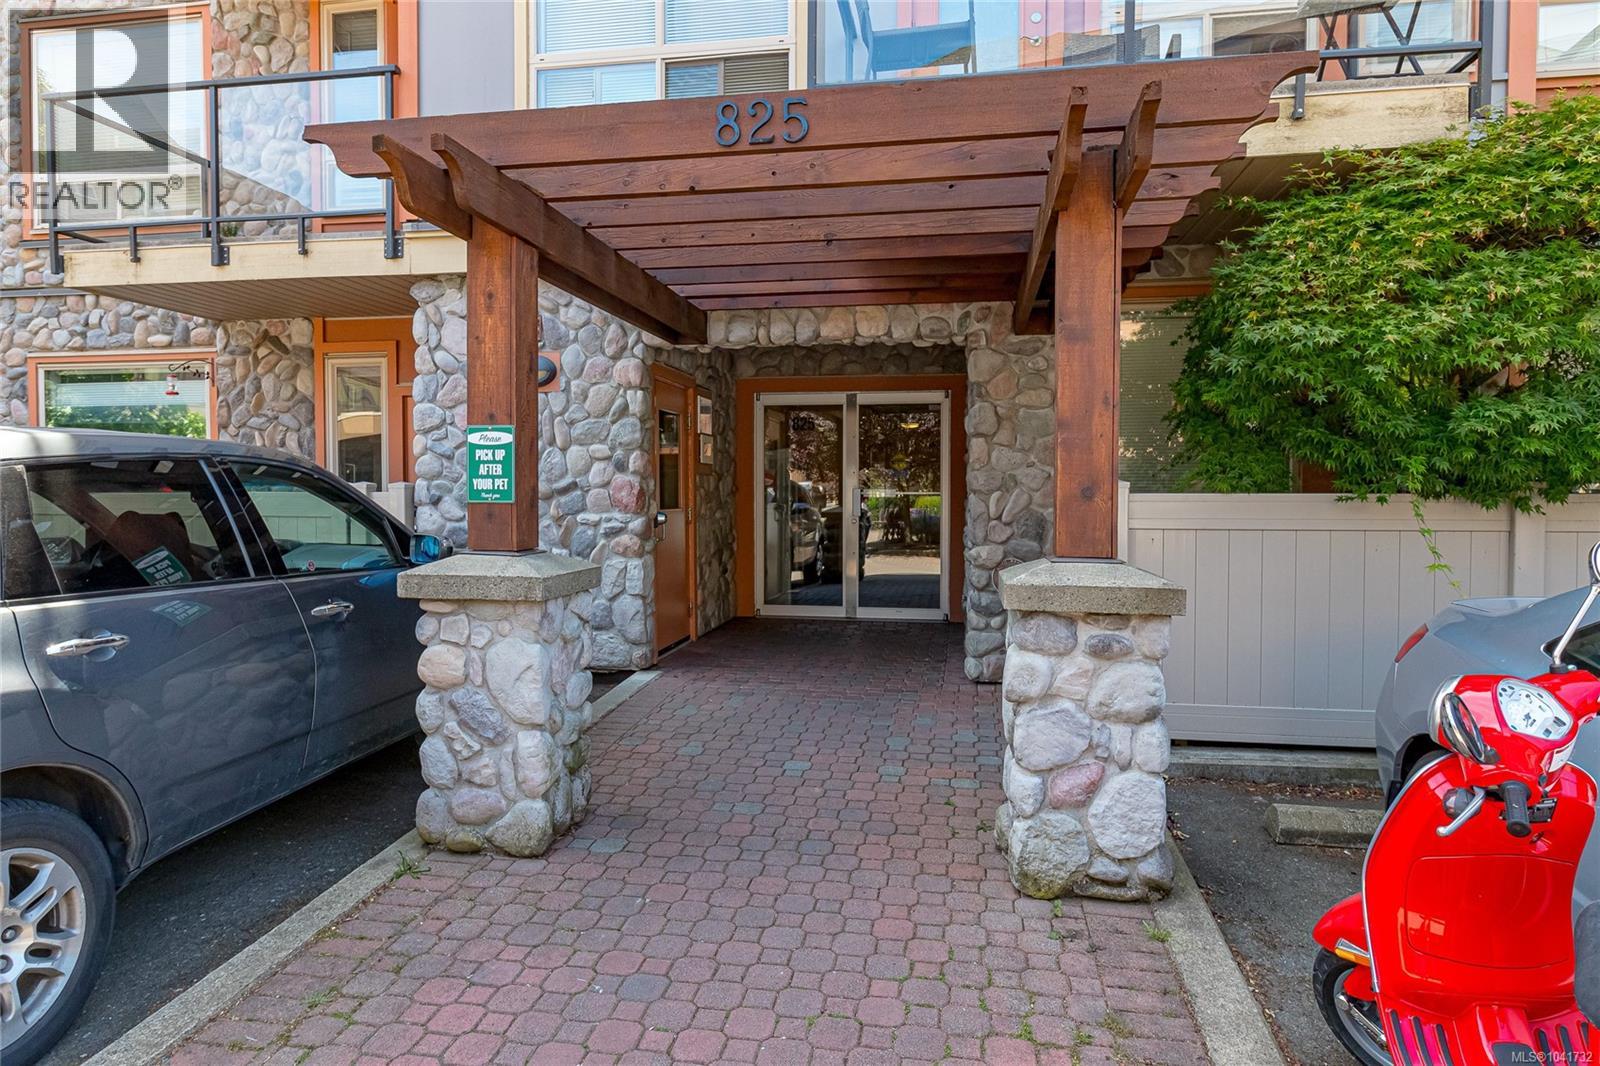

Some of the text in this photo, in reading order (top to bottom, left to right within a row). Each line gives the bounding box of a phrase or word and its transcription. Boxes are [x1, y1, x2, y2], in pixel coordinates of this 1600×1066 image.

[715, 97, 809, 147] 825
[478, 433, 502, 443] Please
[476, 450, 506, 460] PICK UP
[479, 464, 502, 475] AFTER
[472, 479, 508, 490] YOUR PET
